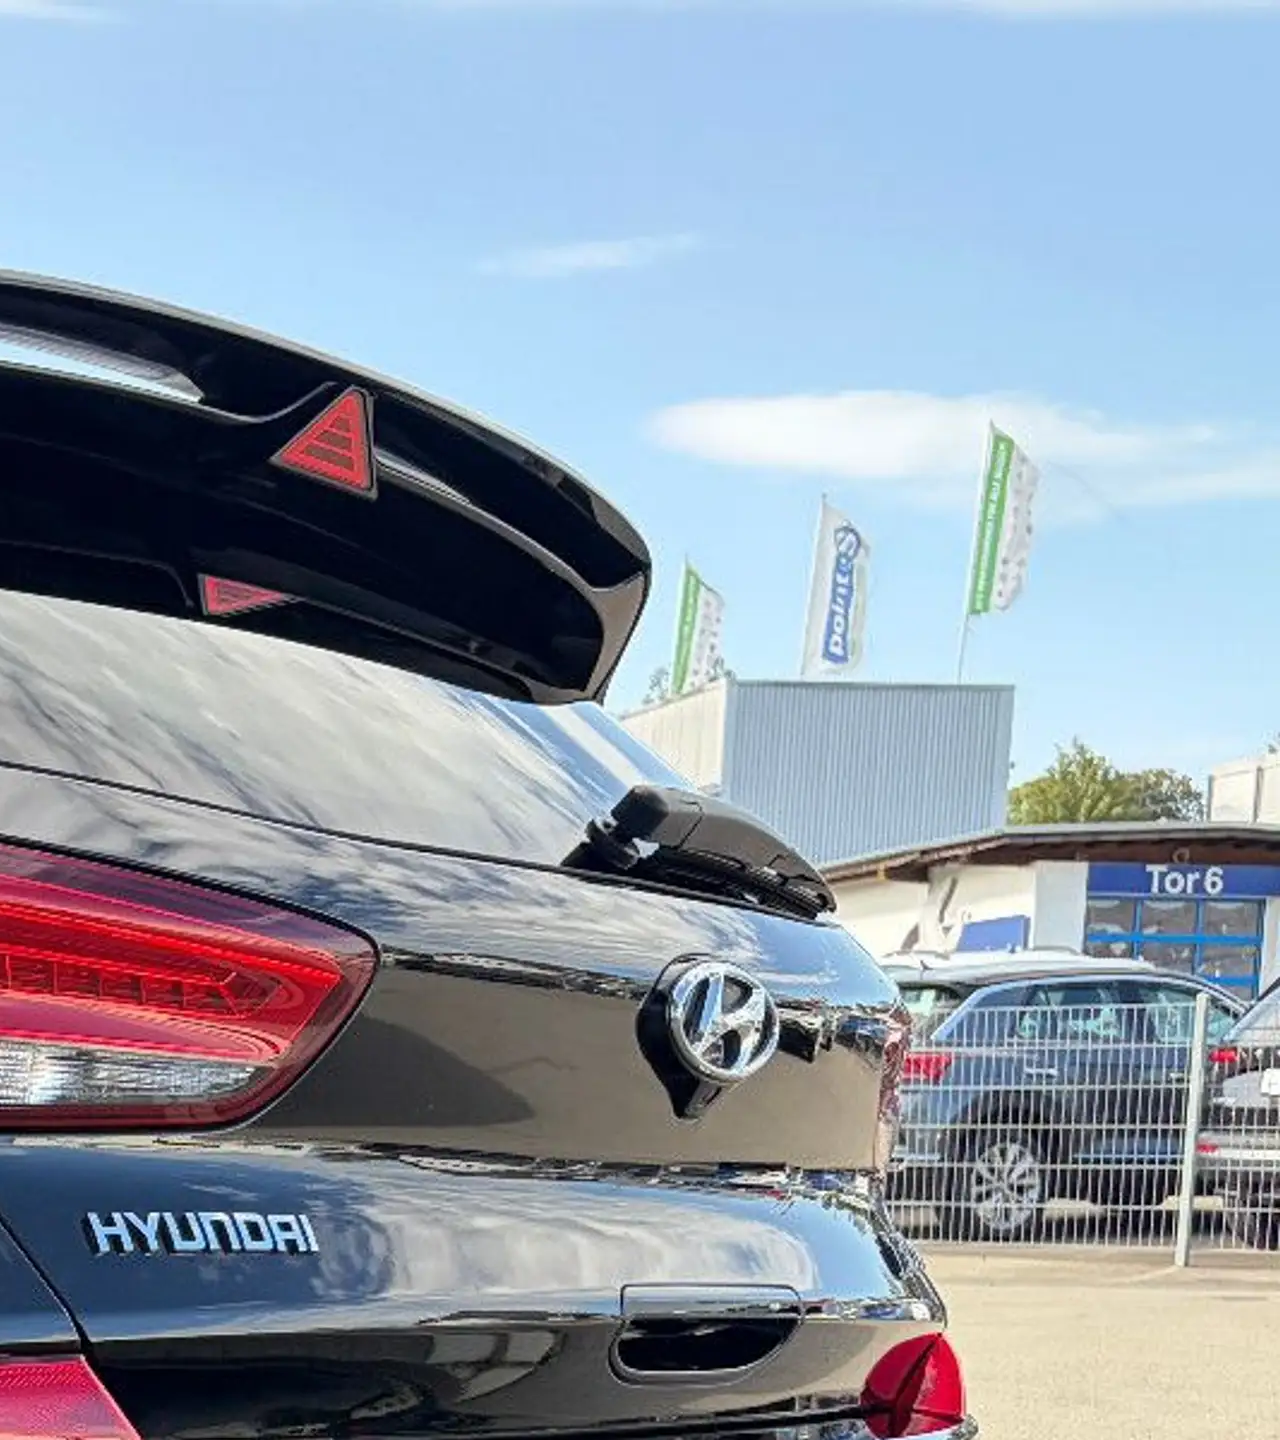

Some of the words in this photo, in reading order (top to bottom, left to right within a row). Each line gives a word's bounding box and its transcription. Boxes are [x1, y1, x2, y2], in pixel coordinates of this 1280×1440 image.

[1145, 863, 1201, 895] Tor
[1204, 865, 1225, 896] 6
[86, 1211, 320, 1252] HYUNDAI
